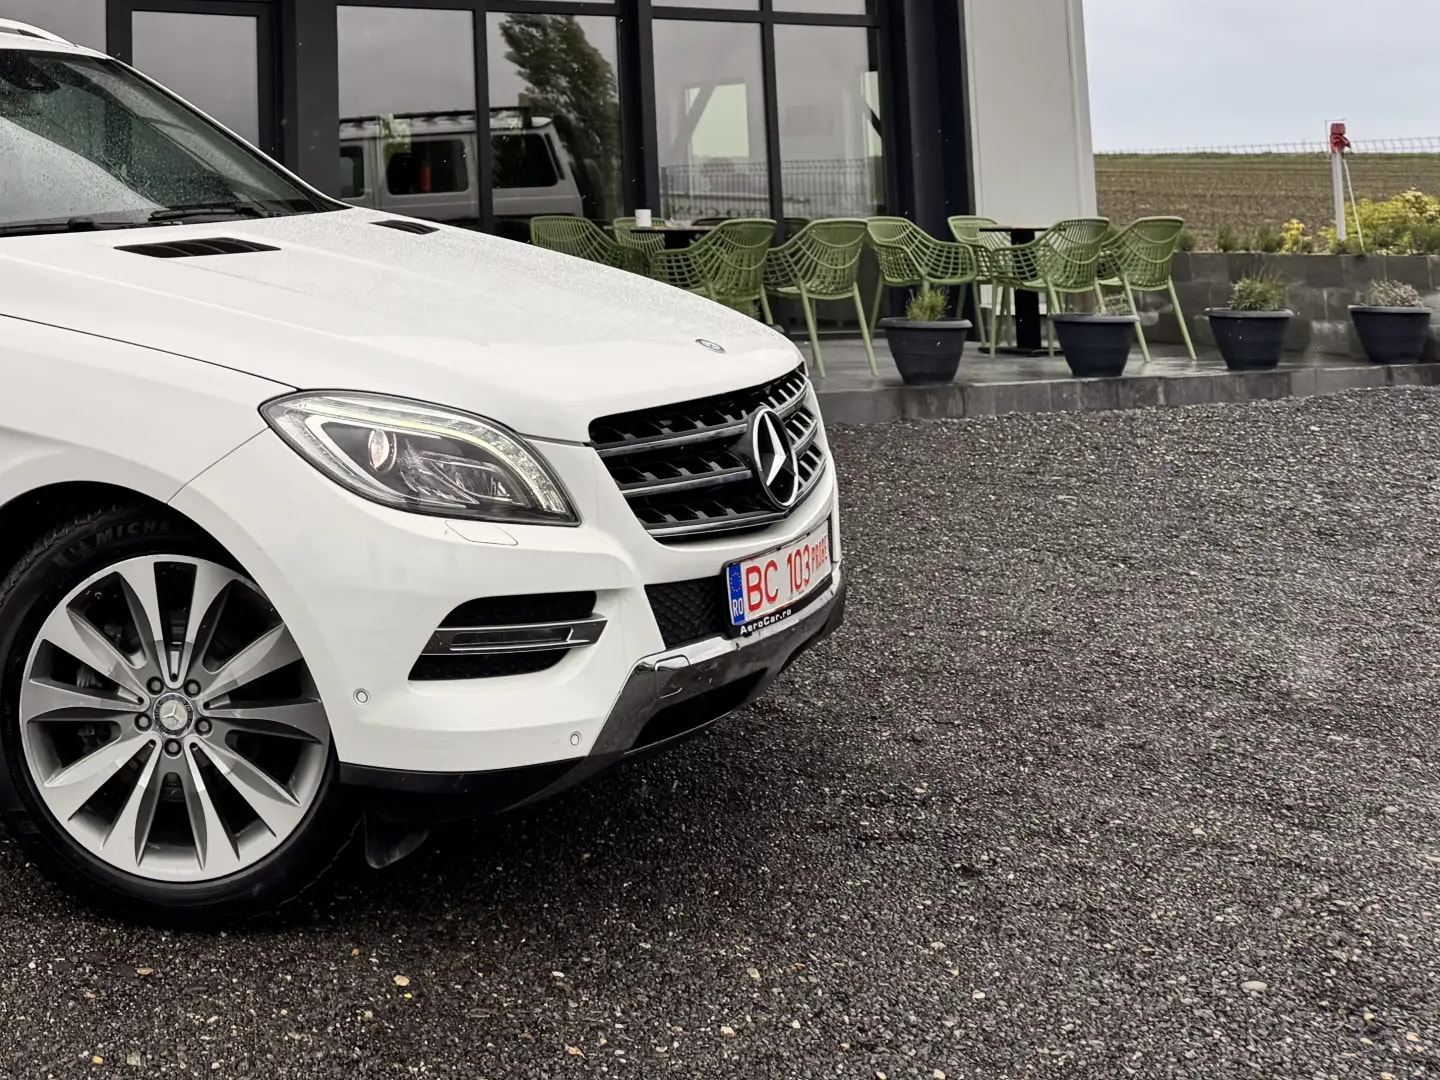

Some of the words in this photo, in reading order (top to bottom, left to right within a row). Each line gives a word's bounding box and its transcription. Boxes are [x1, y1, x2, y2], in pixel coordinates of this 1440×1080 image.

[732, 598, 744, 617] RO
[745, 560, 779, 612] BC
[787, 544, 811, 593] 103
[740, 609, 792, 635] AeroCar.ro
